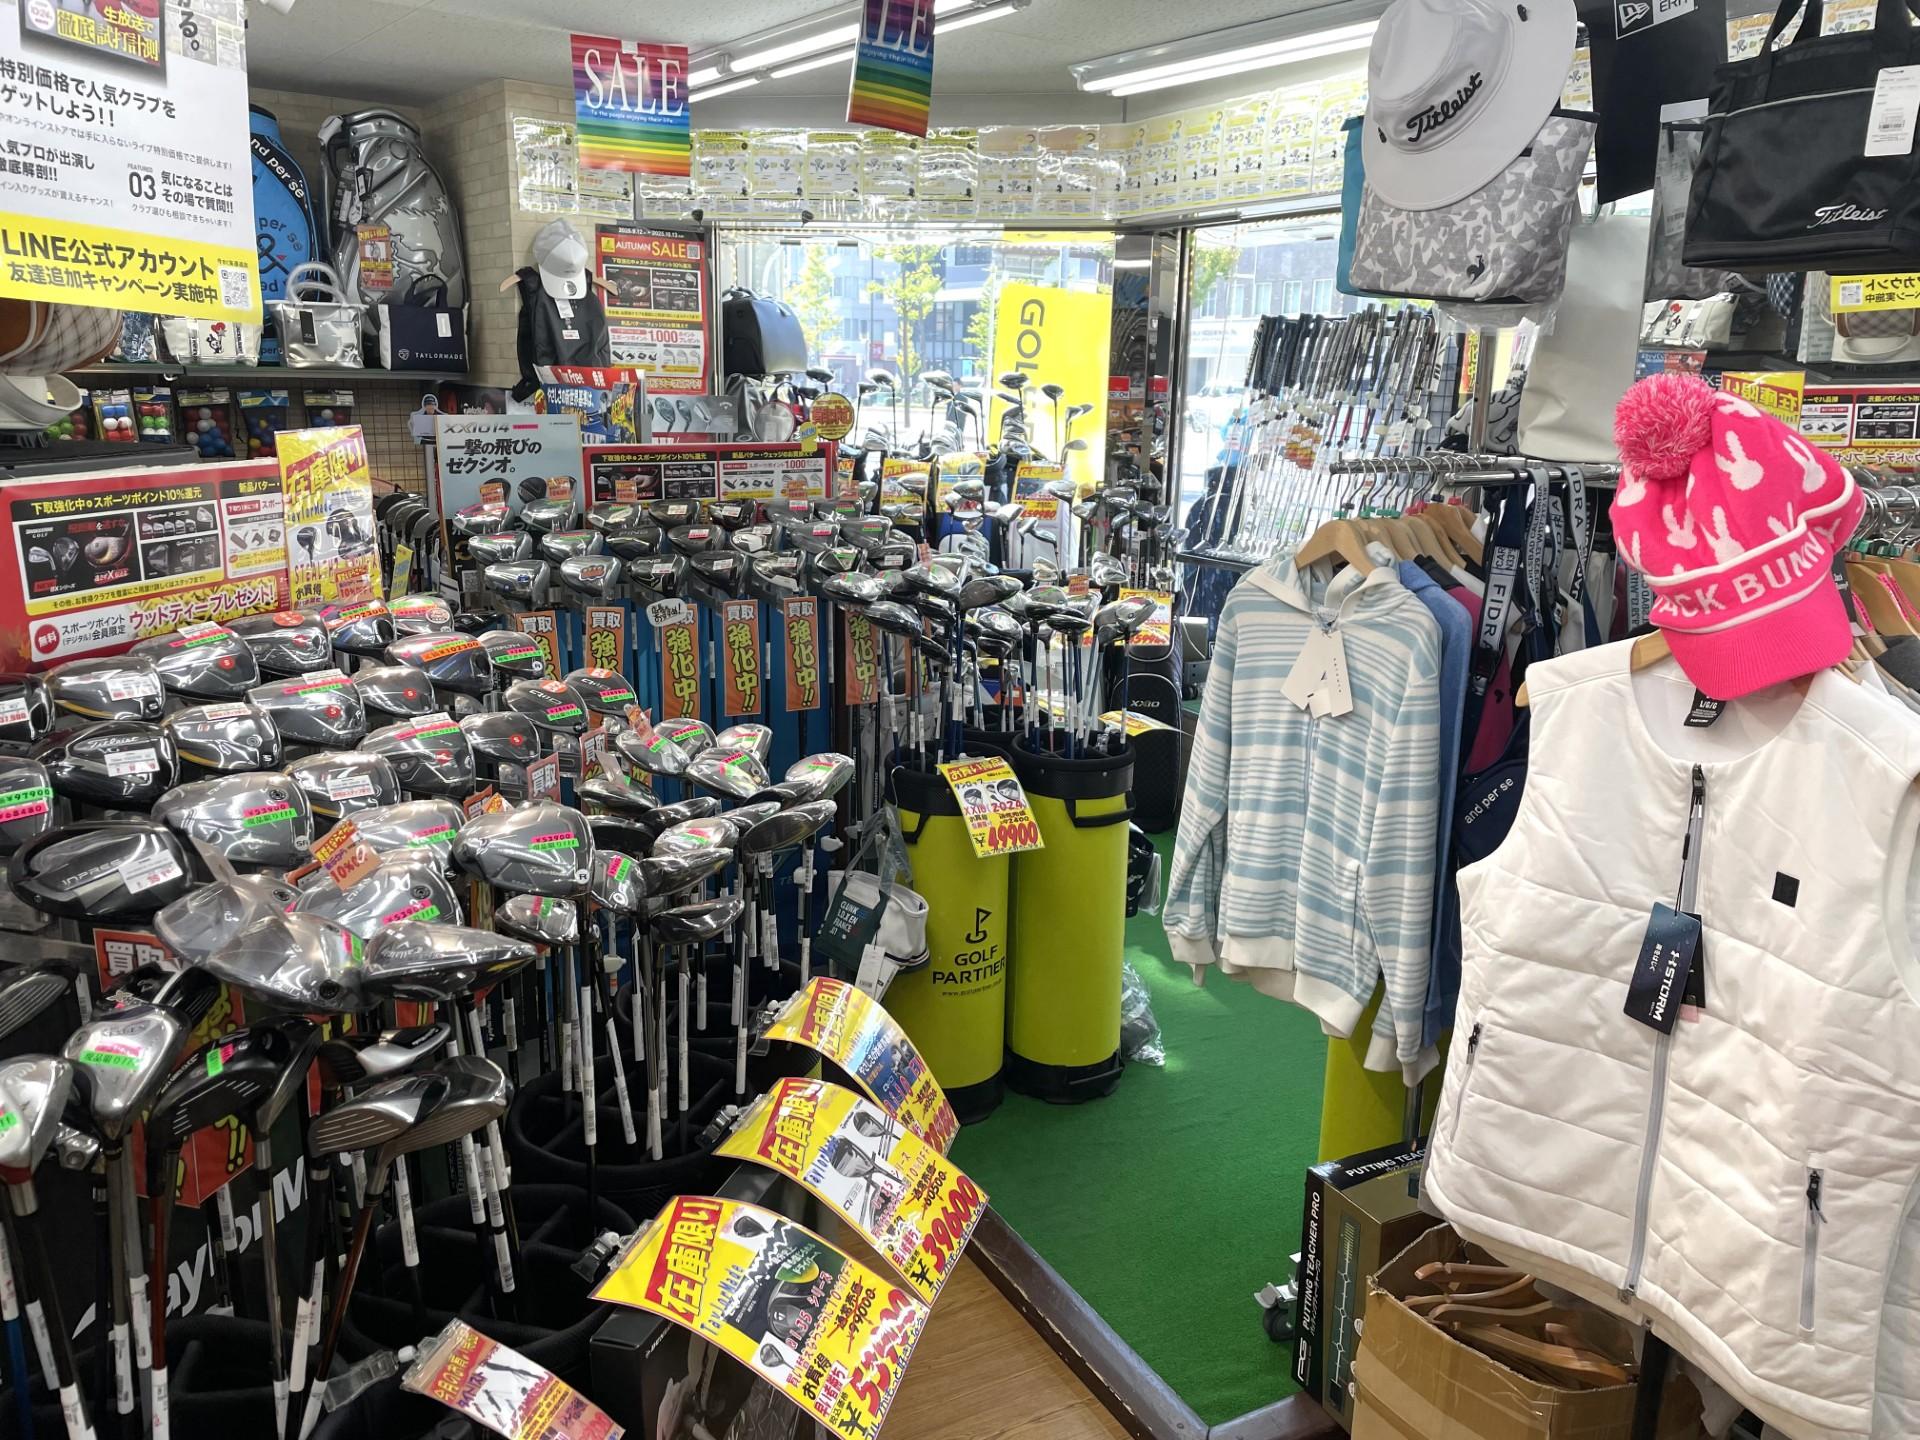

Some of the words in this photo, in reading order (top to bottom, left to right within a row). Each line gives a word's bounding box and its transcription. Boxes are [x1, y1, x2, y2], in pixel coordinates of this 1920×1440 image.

[103, 5, 154, 33] 生放送で
[0, 57, 176, 119] 特別価格で人気クラブを
[584, 48, 684, 117] SALE
[1406, 72, 1483, 142] Titleist
[129, 171, 157, 201] 03
[161, 170, 233, 198] 気になることは
[266, 155, 291, 182] per
[288, 180, 305, 199] se
[259, 215, 287, 231] per
[1807, 204, 1888, 229] Titleist
[1, 228, 214, 281] LINE公式アカウント
[616, 241, 651, 252] AUTUMN
[652, 241, 686, 258] SALE
[8, 261, 218, 305] 友達追加キャンペーン実施中
[415, 351, 464, 360] TAYLORMADE
[447, 438, 542, 456] 一撃の飛びの
[287, 438, 363, 504] 在庫限り
[446, 457, 515, 474] ゼクシオ。
[61, 615, 127, 635] スポーツポイント
[521, 616, 553, 634] 買取
[591, 611, 621, 629] 買取
[726, 605, 756, 622] 買取
[787, 603, 814, 618] 買取
[37, 632, 58, 649] 無料
[726, 622, 759, 713] 強化中!!
[787, 618, 817, 709] 強化中!!
[531, 763, 557, 798] 買取
[1464, 797, 1485, 824] and
[1481, 786, 1502, 812] per
[1499, 776, 1514, 793] se
[987, 821, 1039, 851] 49900
[933, 957, 1006, 985] PARTNER
[954, 944, 998, 967] GOLF
[1653, 967, 1676, 1021] STORM
[766, 1079, 824, 1175] 在庫限り
[1347, 1158, 1397, 1179] PUTTING
[922, 1174, 982, 1271] 39600
[1311, 1191, 1321, 1223] PRO
[660, 1199, 720, 1323] 在庫限り
[1305, 1224, 1318, 1278] TEACHER
[909, 1260, 937, 1289] ¥
[1302, 1279, 1314, 1331] PUTTING
[800, 1353, 831, 1400] お買得
[838, 1404, 871, 1438] ¥
